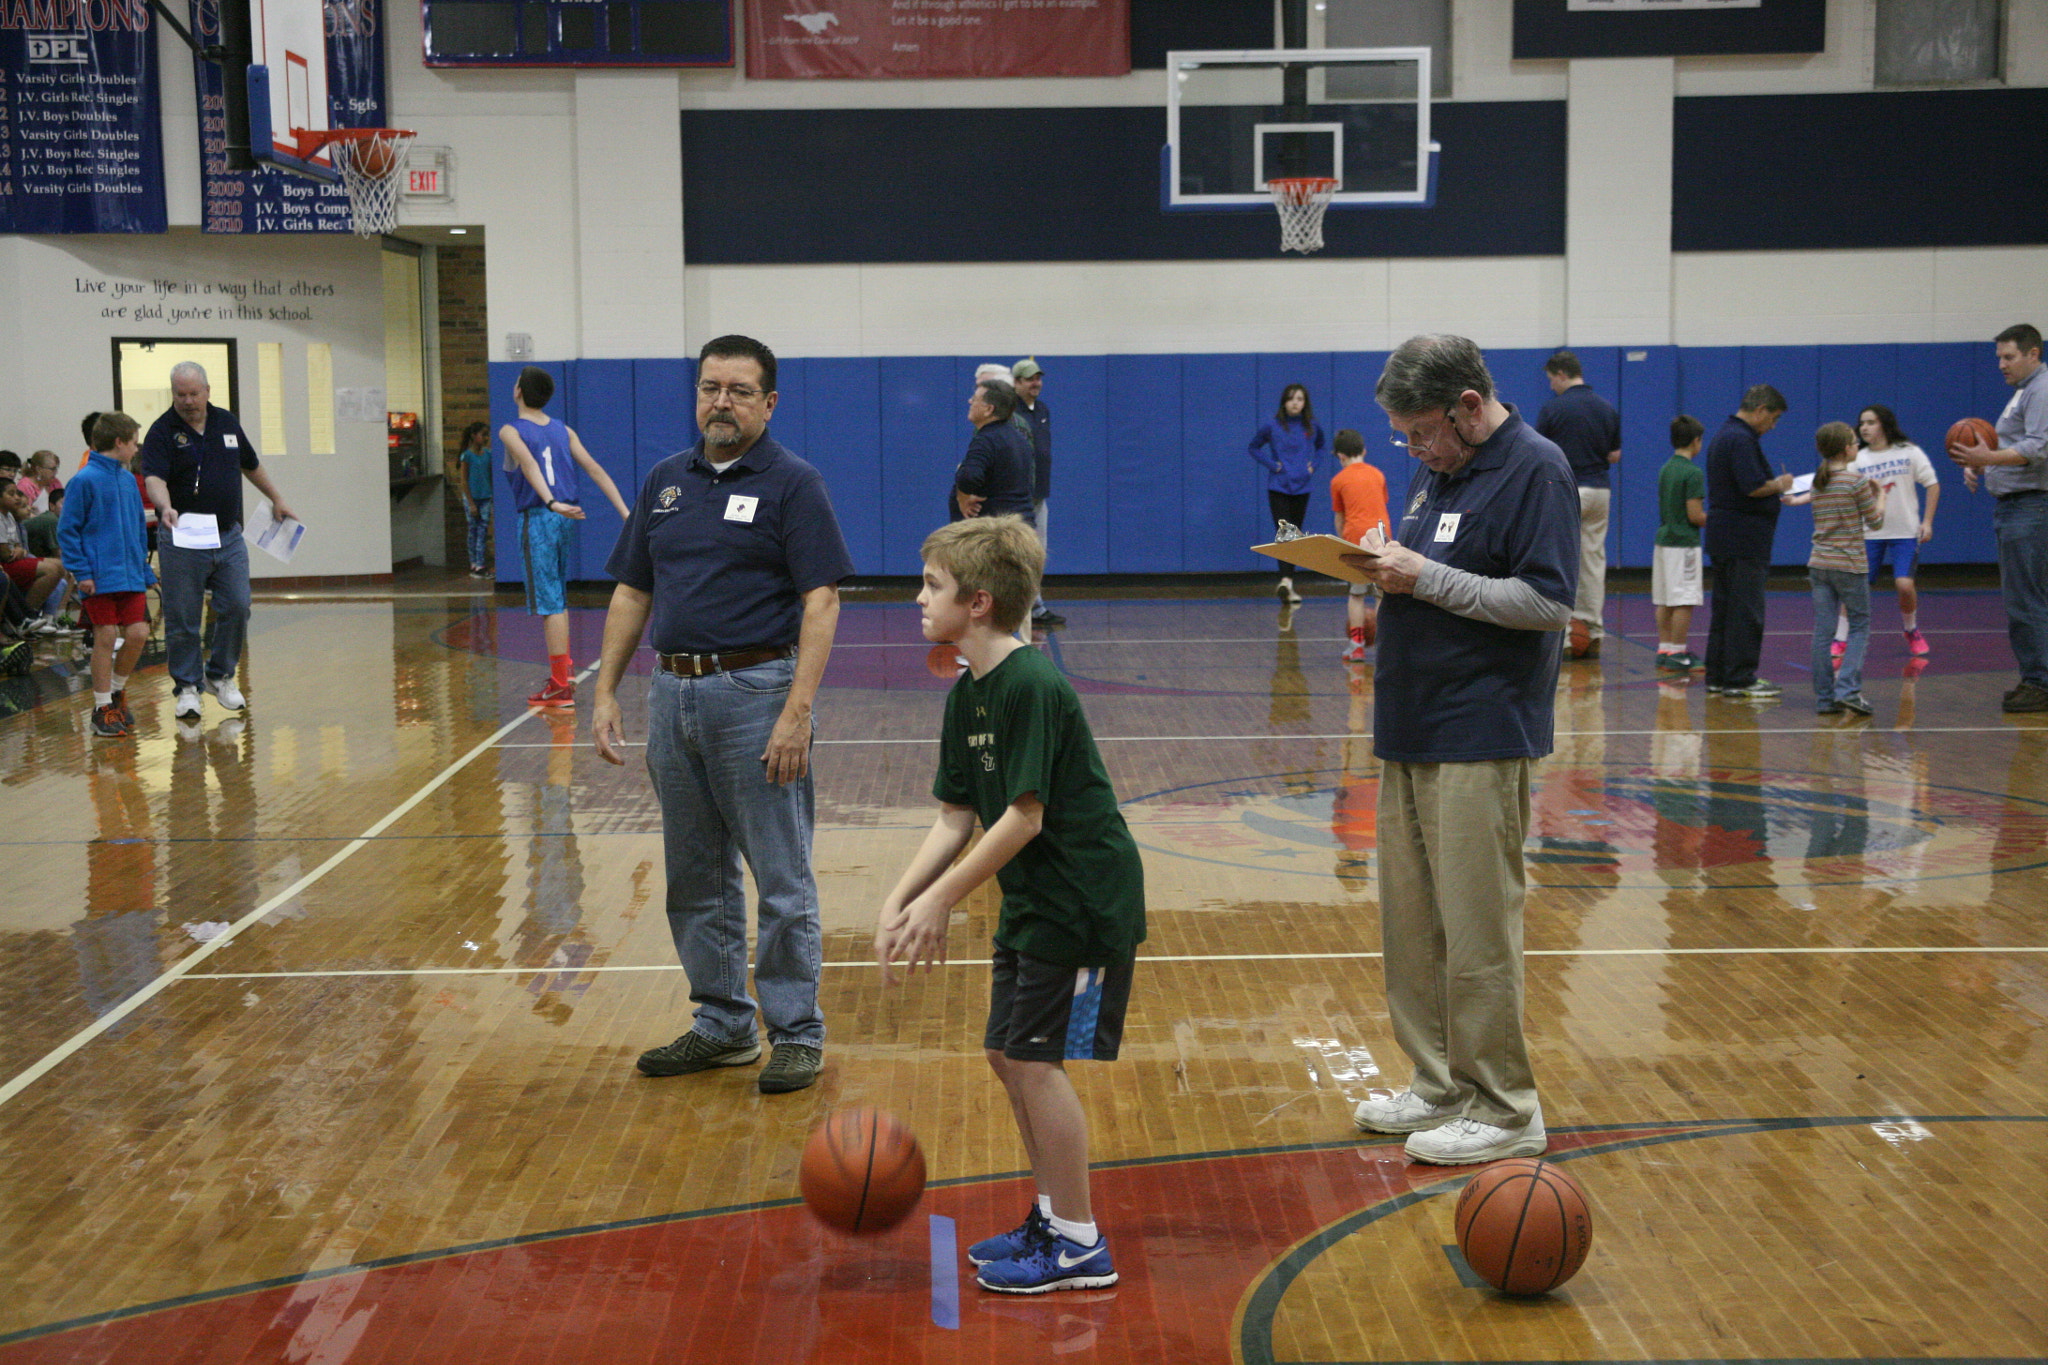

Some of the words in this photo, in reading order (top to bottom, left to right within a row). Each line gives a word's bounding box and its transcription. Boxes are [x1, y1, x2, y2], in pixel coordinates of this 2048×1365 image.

[892, 16, 906, 26] Let
[938, 15, 962, 28] good
[29, 40, 88, 58] DPL
[16, 74, 57, 86] Varsity
[60, 74, 86, 84] Girls
[88, 74, 137, 85] Doubles
[17, 92, 38, 104] J.V.
[41, 92, 70, 103] Girls
[71, 92, 94, 102] Rec.
[96, 93, 139, 106] Singles
[348, 98, 378, 114] Sgls
[18, 111, 40, 124] J.V.
[43, 111, 70, 124] Boys
[72, 111, 118, 122] Doubles
[20, 130, 60, 142] Varsity
[64, 130, 88, 140] Girls
[91, 130, 140, 141] Doubles
[21, 148, 43, 161] J.V.
[46, 148, 72, 162] Boys
[74, 149, 95, 159] Rec.
[97, 150, 140, 162] Singles
[22, 166, 44, 178] J.V.
[48, 166, 74, 178] Boys
[76, 166, 94, 175] Rec
[97, 165, 140, 178] Singles
[24, 184, 65, 196] Varsity
[68, 184, 92, 194] Girls
[95, 183, 144, 194] Doubles
[410, 171, 438, 192] EXIT
[207, 180, 245, 196] 2009
[252, 184, 264, 196] V
[282, 184, 314, 200] Boys
[319, 184, 350, 197] Dbls
[207, 200, 243, 216] 2010
[256, 202, 278, 218] J.V.
[282, 202, 311, 218] Boys
[314, 202, 352, 218] Comp.
[208, 217, 244, 232] 2010
[256, 218, 279, 233] J.V.
[282, 219, 314, 231] Girls
[318, 219, 343, 231] Rec.
[75, 278, 107, 294] Live
[111, 282, 146, 300] your
[153, 278, 178, 300] life
[184, 280, 198, 294] in
[204, 285, 212, 294] a
[218, 282, 248, 300] way
[252, 279, 282, 296] that
[289, 280, 335, 297] others
[101, 305, 128, 318] are
[134, 302, 163, 322] glad
[167, 306, 212, 324] you're
[219, 304, 233, 320] in
[237, 303, 263, 320] this
[542, 446, 555, 486] 1
[1858, 458, 1912, 474] MUSTANG
